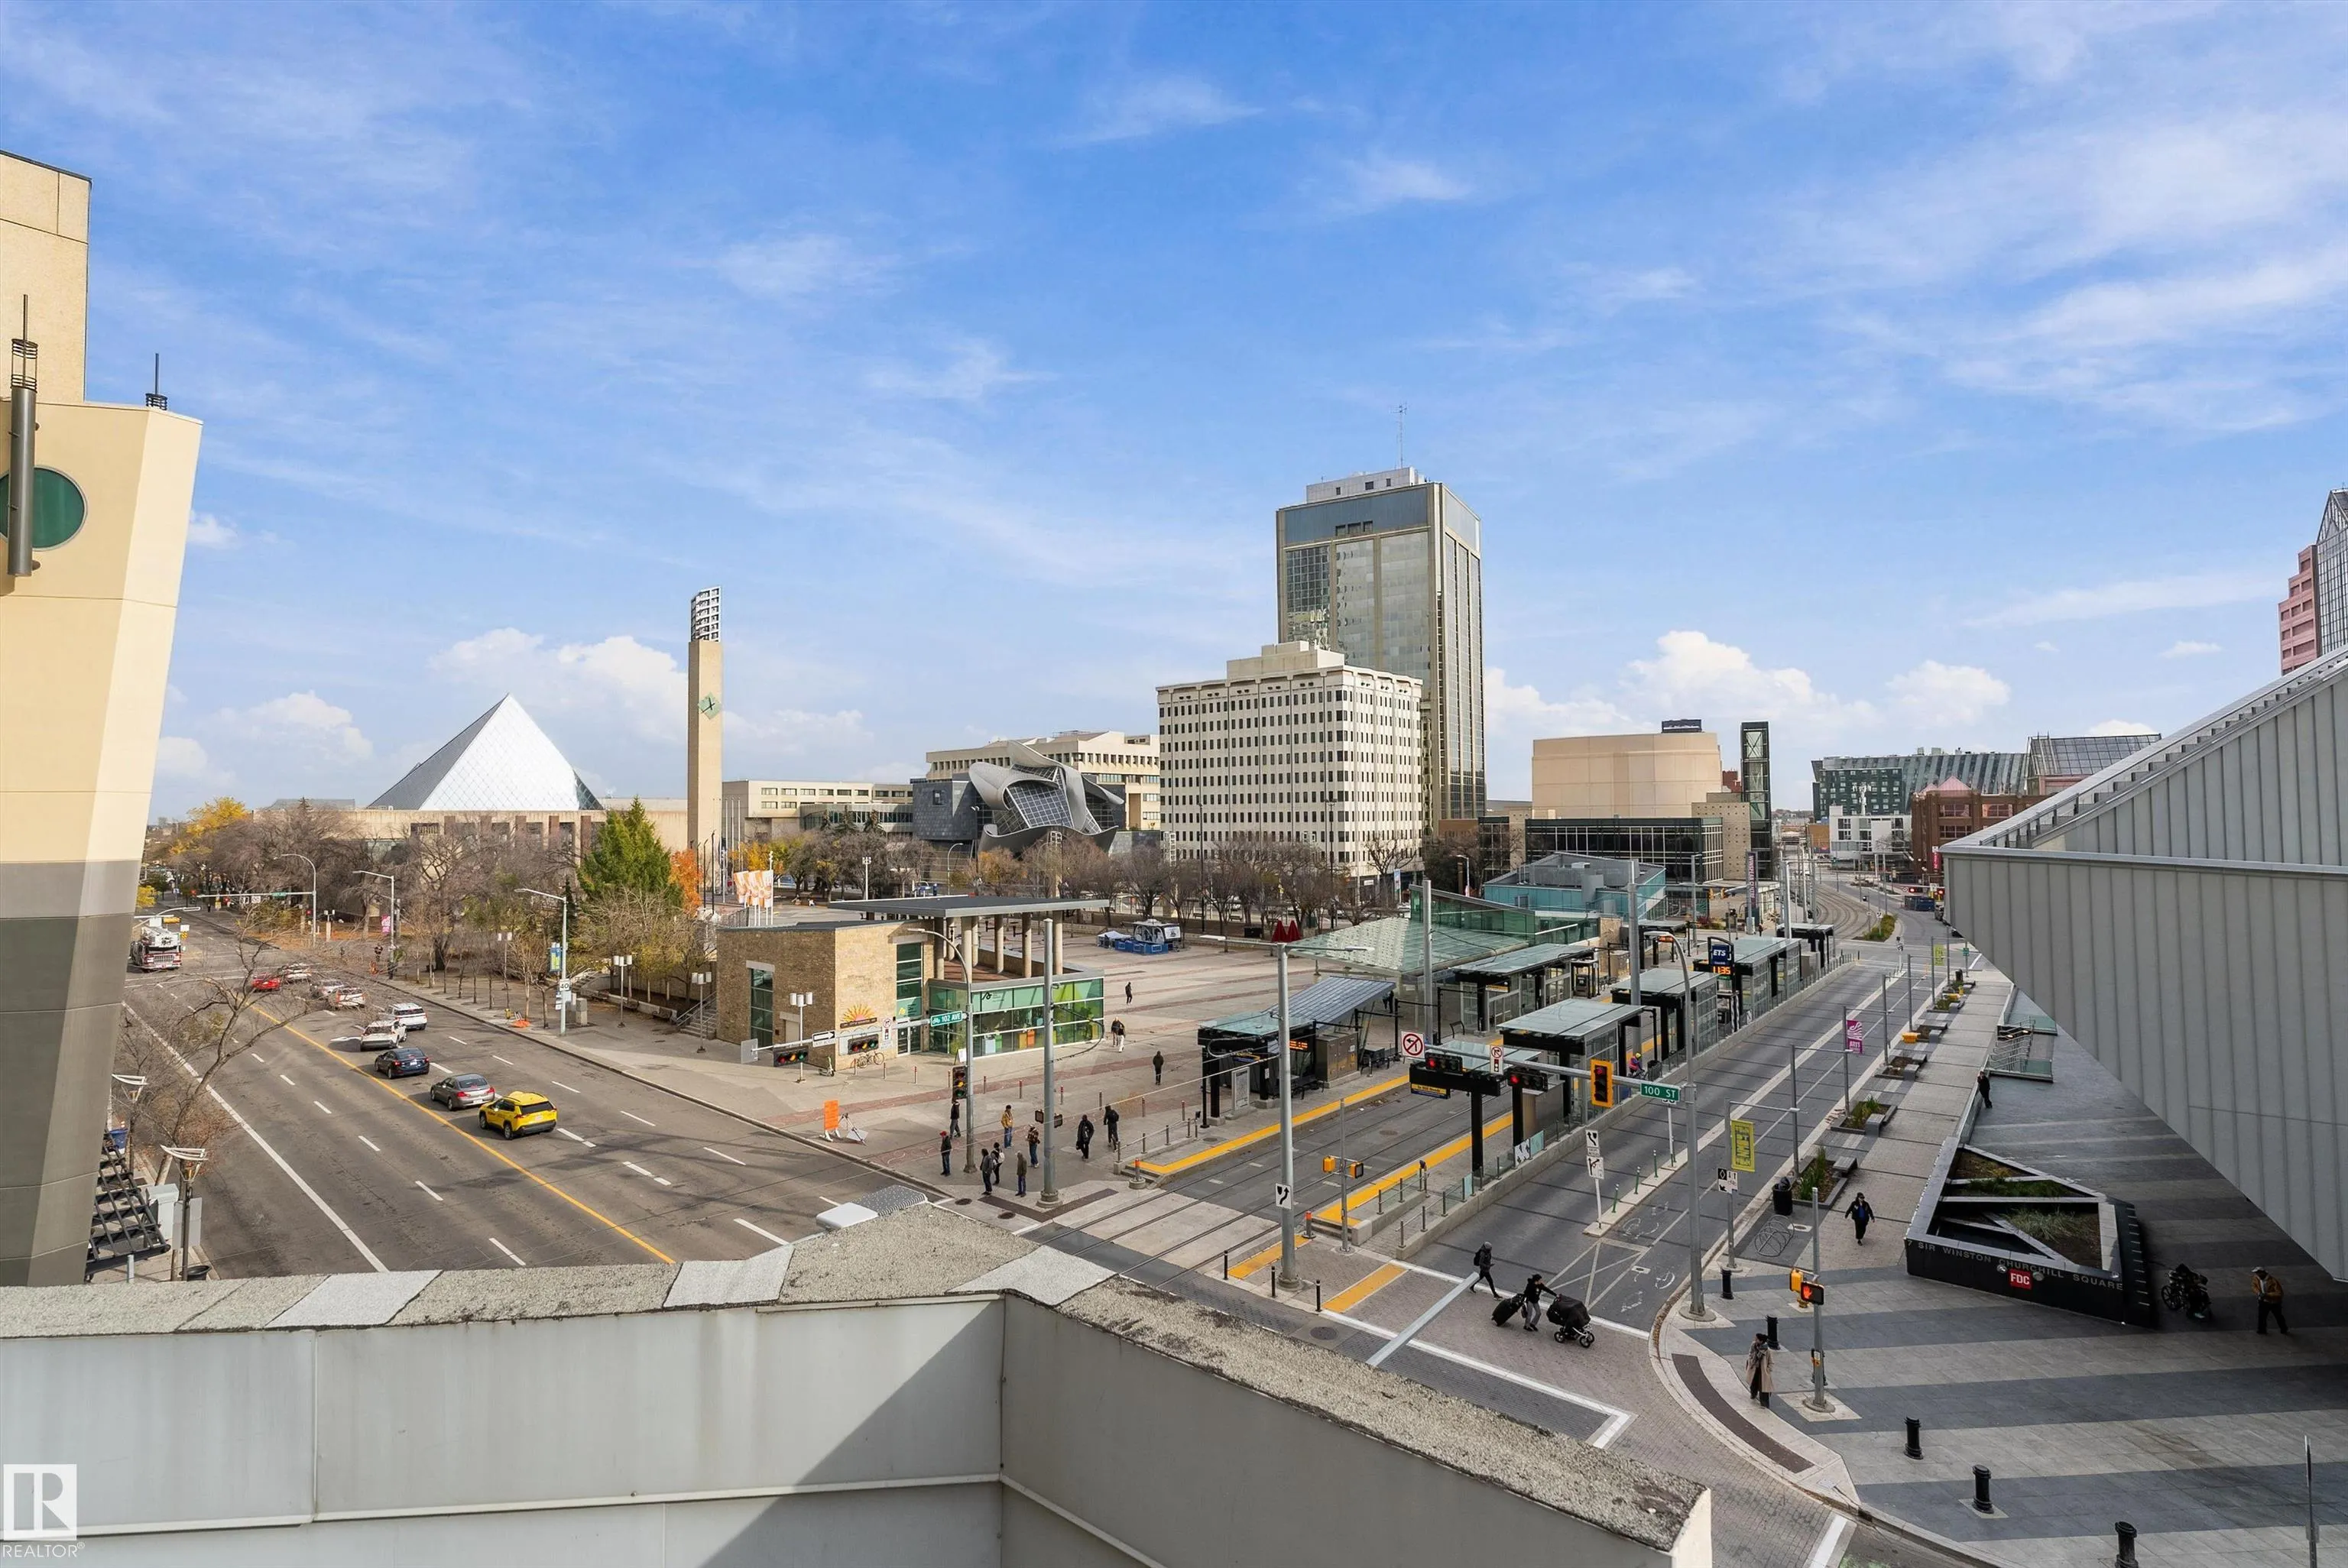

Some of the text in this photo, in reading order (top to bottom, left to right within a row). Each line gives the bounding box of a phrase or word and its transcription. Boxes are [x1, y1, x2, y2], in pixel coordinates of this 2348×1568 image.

[942, 1012, 961, 1022] 102 AVE
[1644, 1086, 1676, 1099] 100 ST
[1918, 1242, 1936, 1252] SIR
[1942, 1246, 1992, 1263] WINSTON
[1999, 1259, 2064, 1278] CHURCHILL
[2072, 1273, 2123, 1291] SQUARE
[2010, 1272, 2031, 1285] FDC
